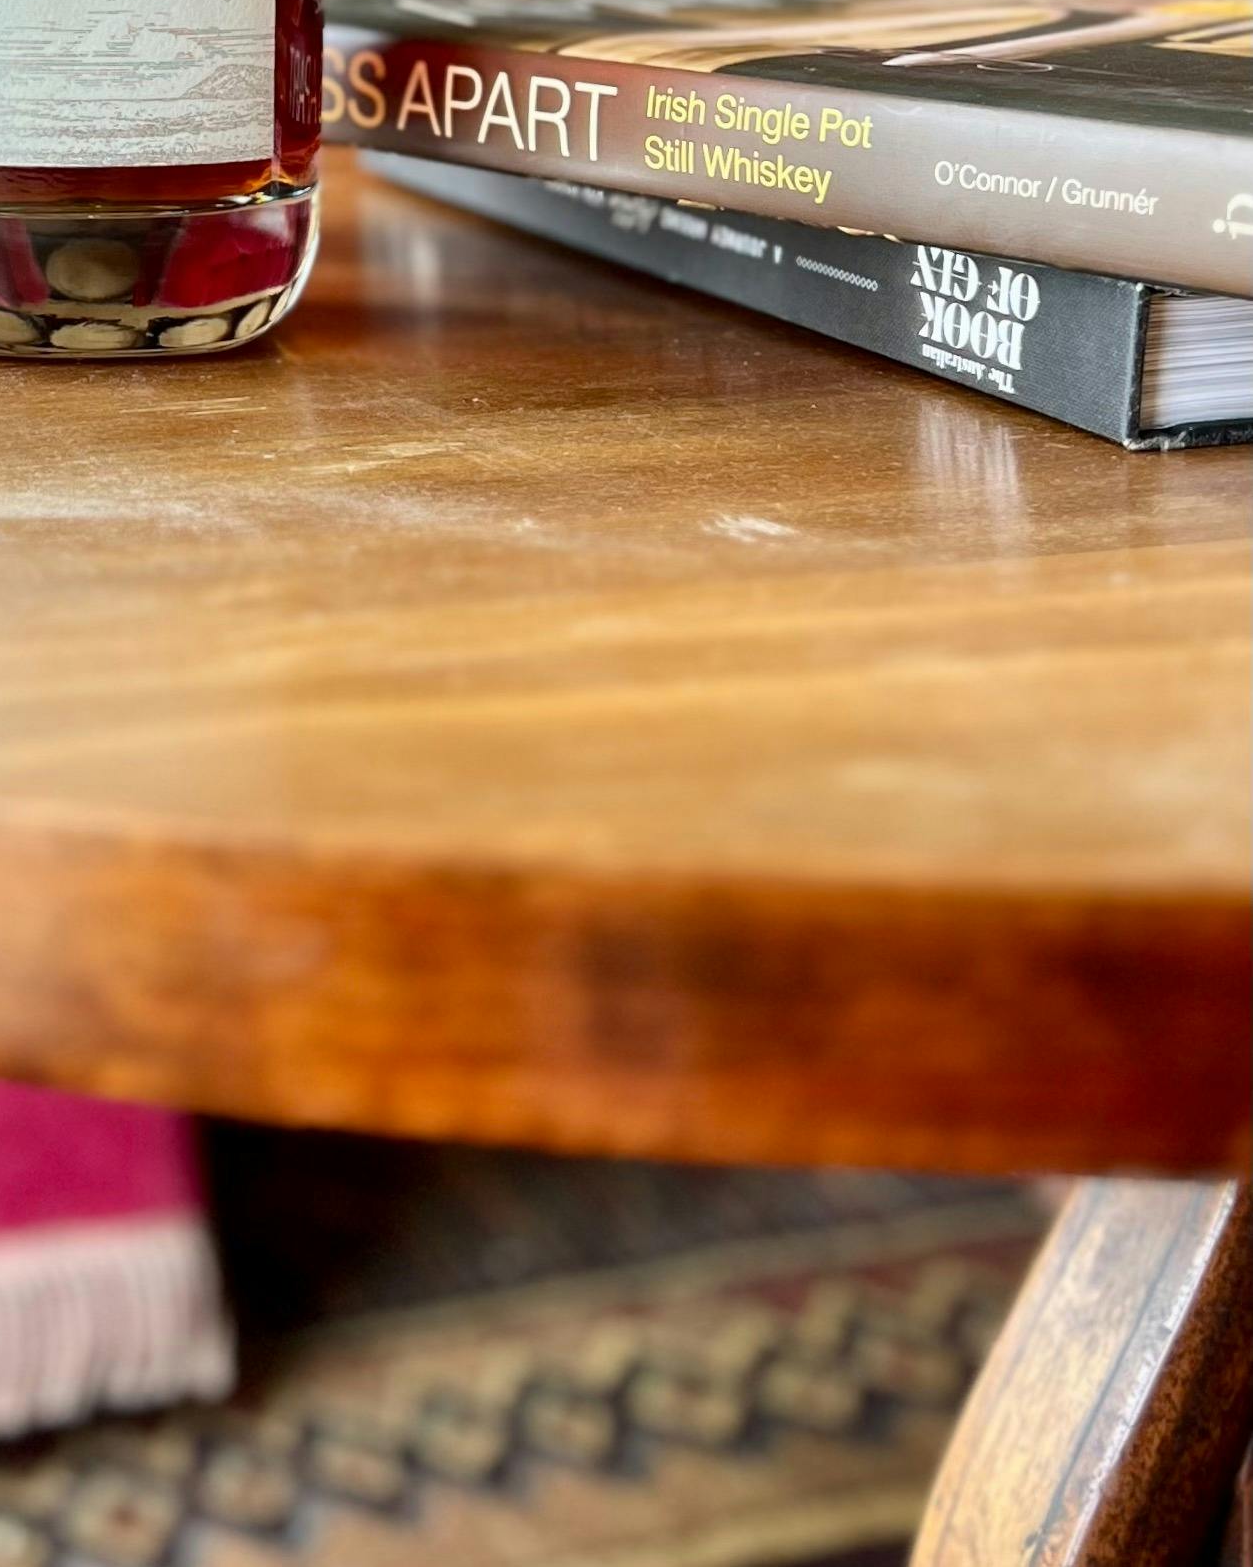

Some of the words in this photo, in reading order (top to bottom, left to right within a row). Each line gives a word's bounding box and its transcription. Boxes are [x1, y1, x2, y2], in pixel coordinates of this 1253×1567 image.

[395, 60, 619, 162] APART
[645, 84, 707, 126] Irish
[713, 93, 811, 146] Single
[818, 107, 874, 149] Pot
[643, 135, 695, 175] Still
[702, 143, 833, 205] Whiskey
[934, 160, 1043, 199] O'Connor
[1061, 177, 1160, 216] Grunnér
[909, 244, 983, 303] GIN
[986, 266, 1042, 322] OF
[917, 291, 1026, 371] BOOK
[921, 343, 988, 382] Australian
[987, 367, 1015, 395] The
